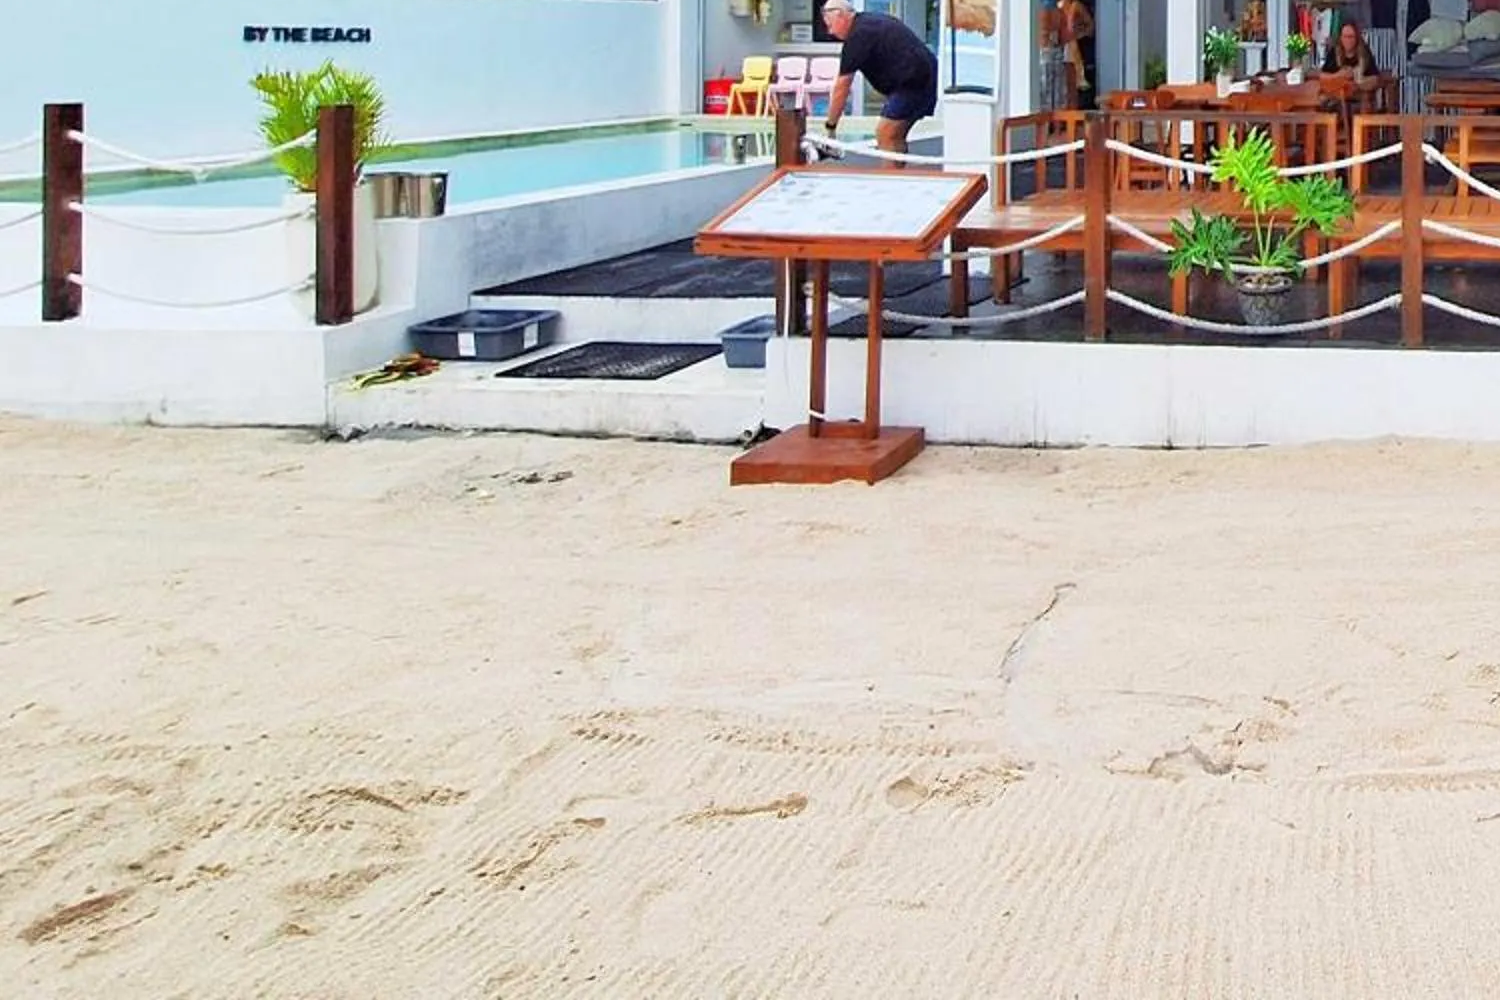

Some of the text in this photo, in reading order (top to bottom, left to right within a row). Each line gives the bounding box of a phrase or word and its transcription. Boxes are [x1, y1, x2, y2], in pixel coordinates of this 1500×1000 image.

[243, 26, 370, 42] BY THE BEACH
